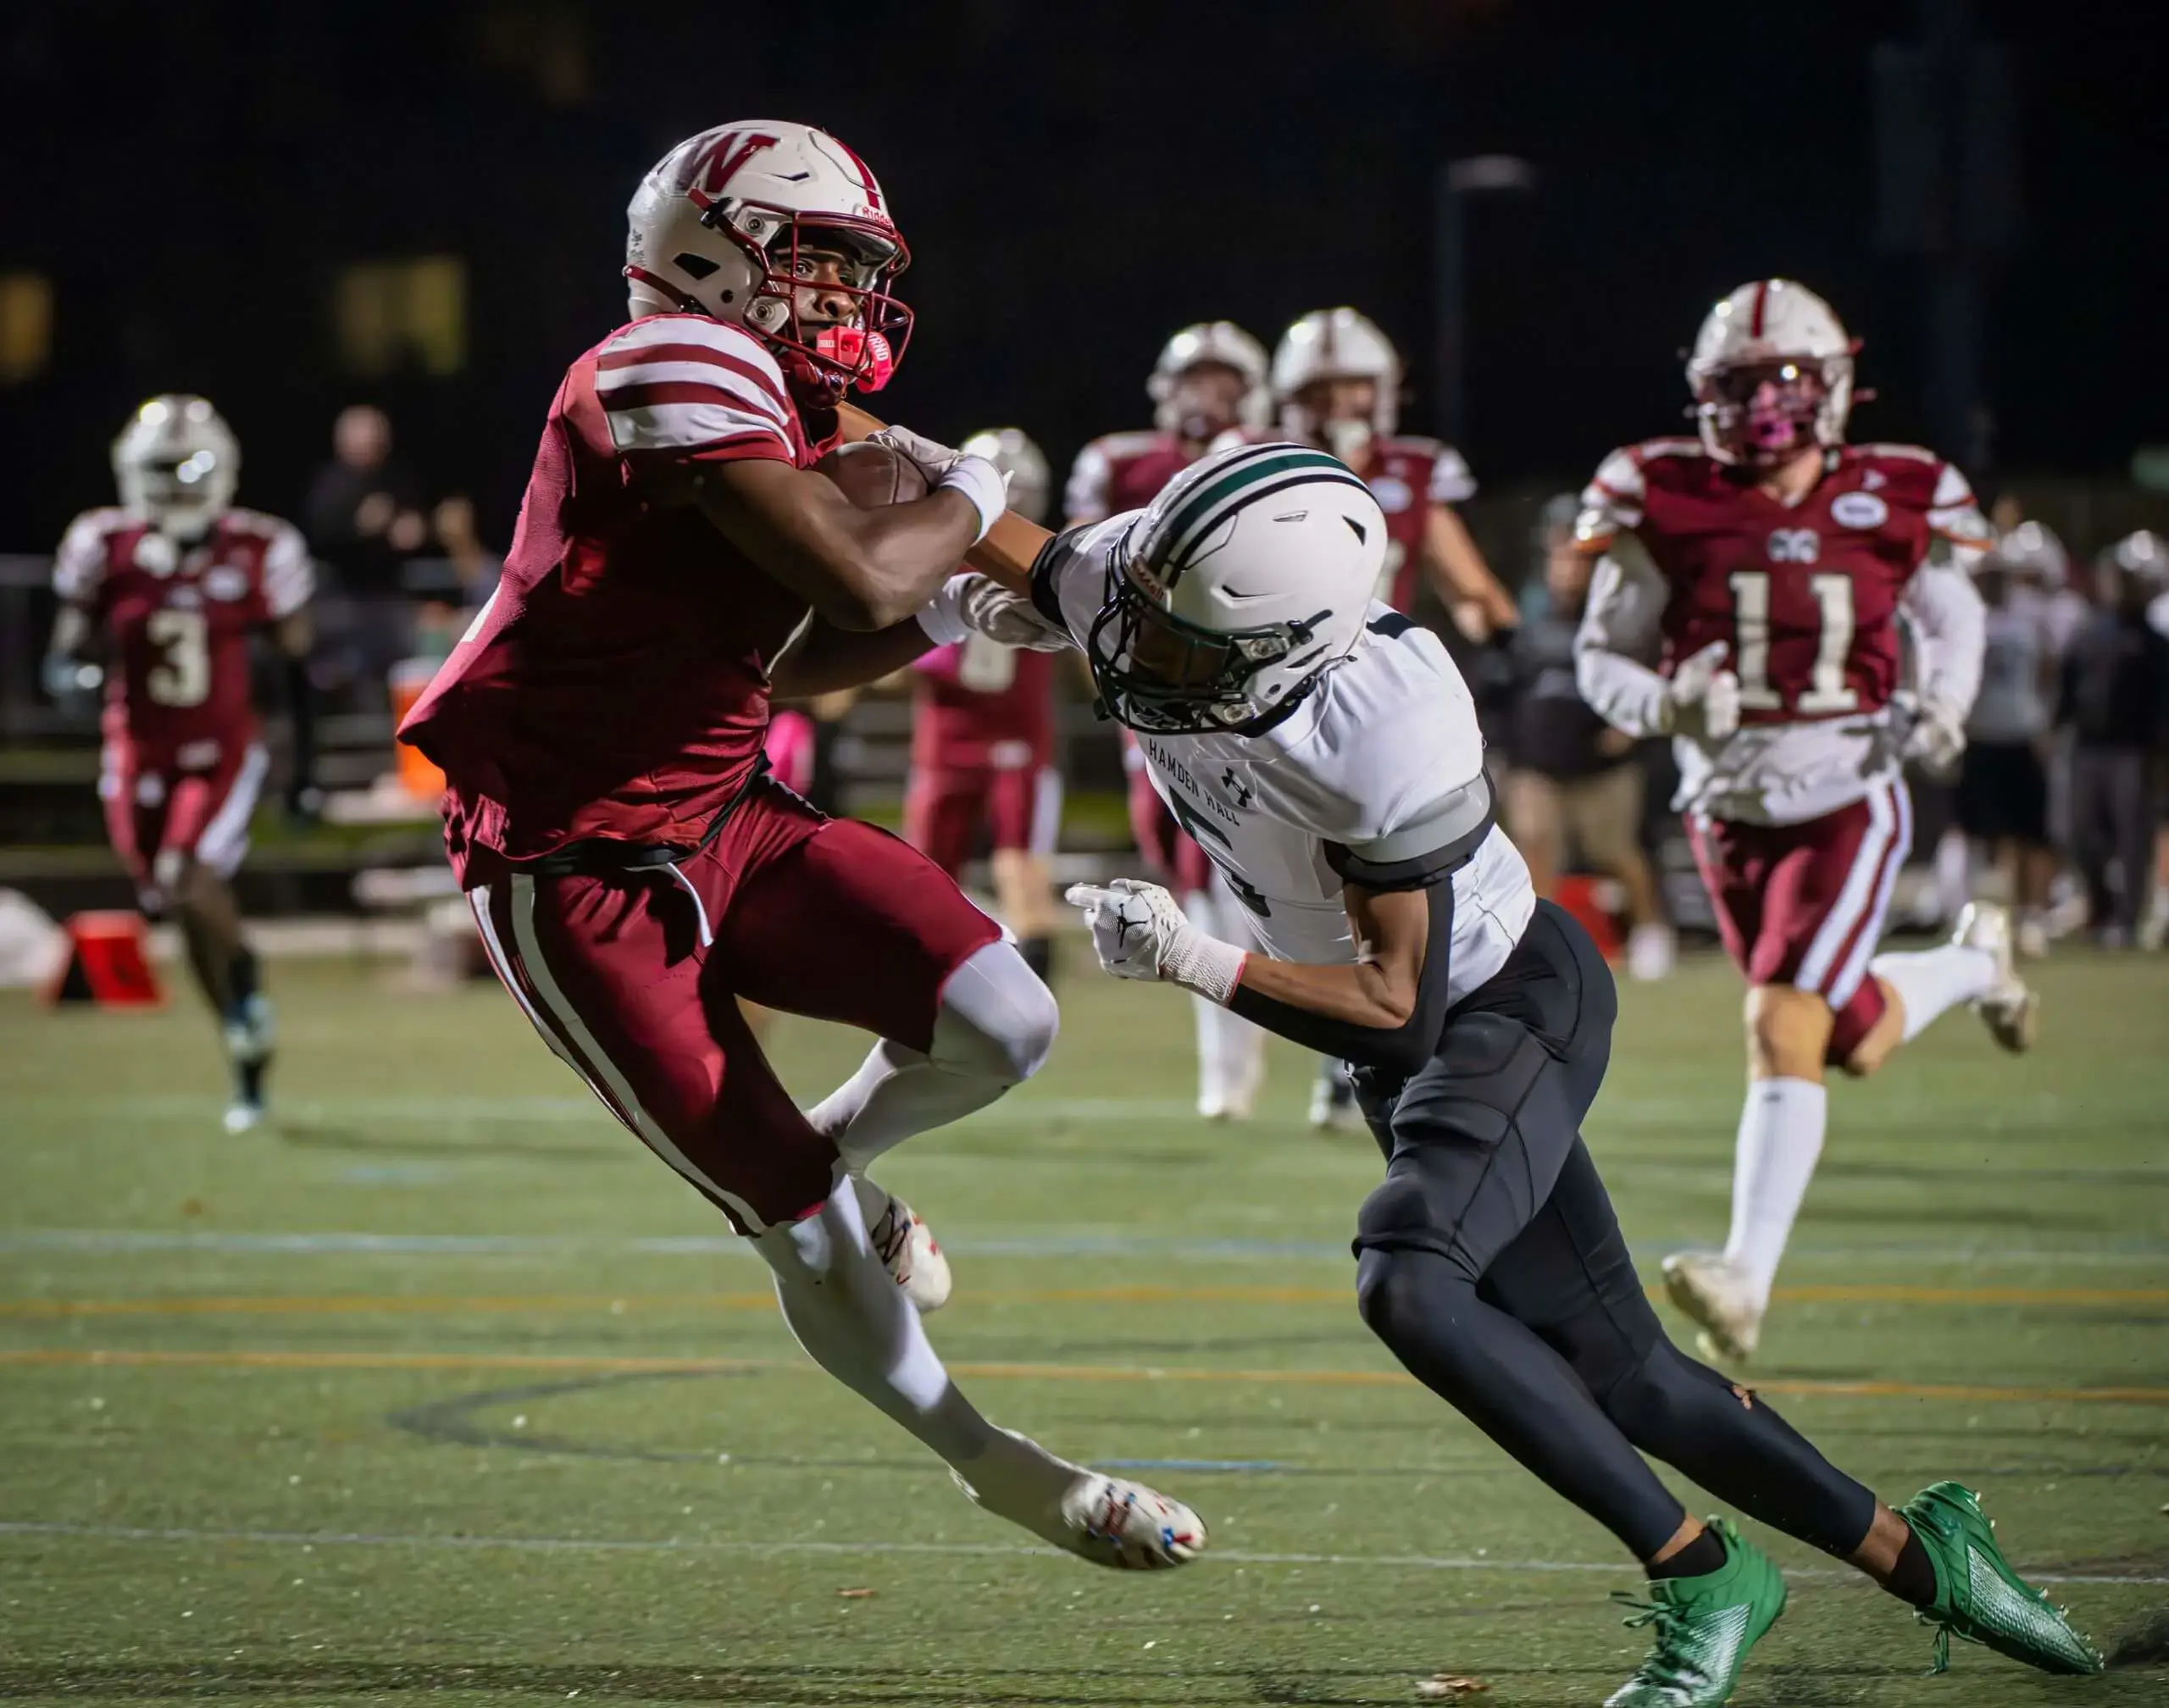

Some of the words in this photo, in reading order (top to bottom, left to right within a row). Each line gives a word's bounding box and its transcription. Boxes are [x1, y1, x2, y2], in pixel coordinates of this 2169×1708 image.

[147, 610, 211, 707] 3
[1728, 571, 1857, 711] 11
[1149, 738, 1200, 797] HAMDEN
[1204, 790, 1240, 827] HALL
